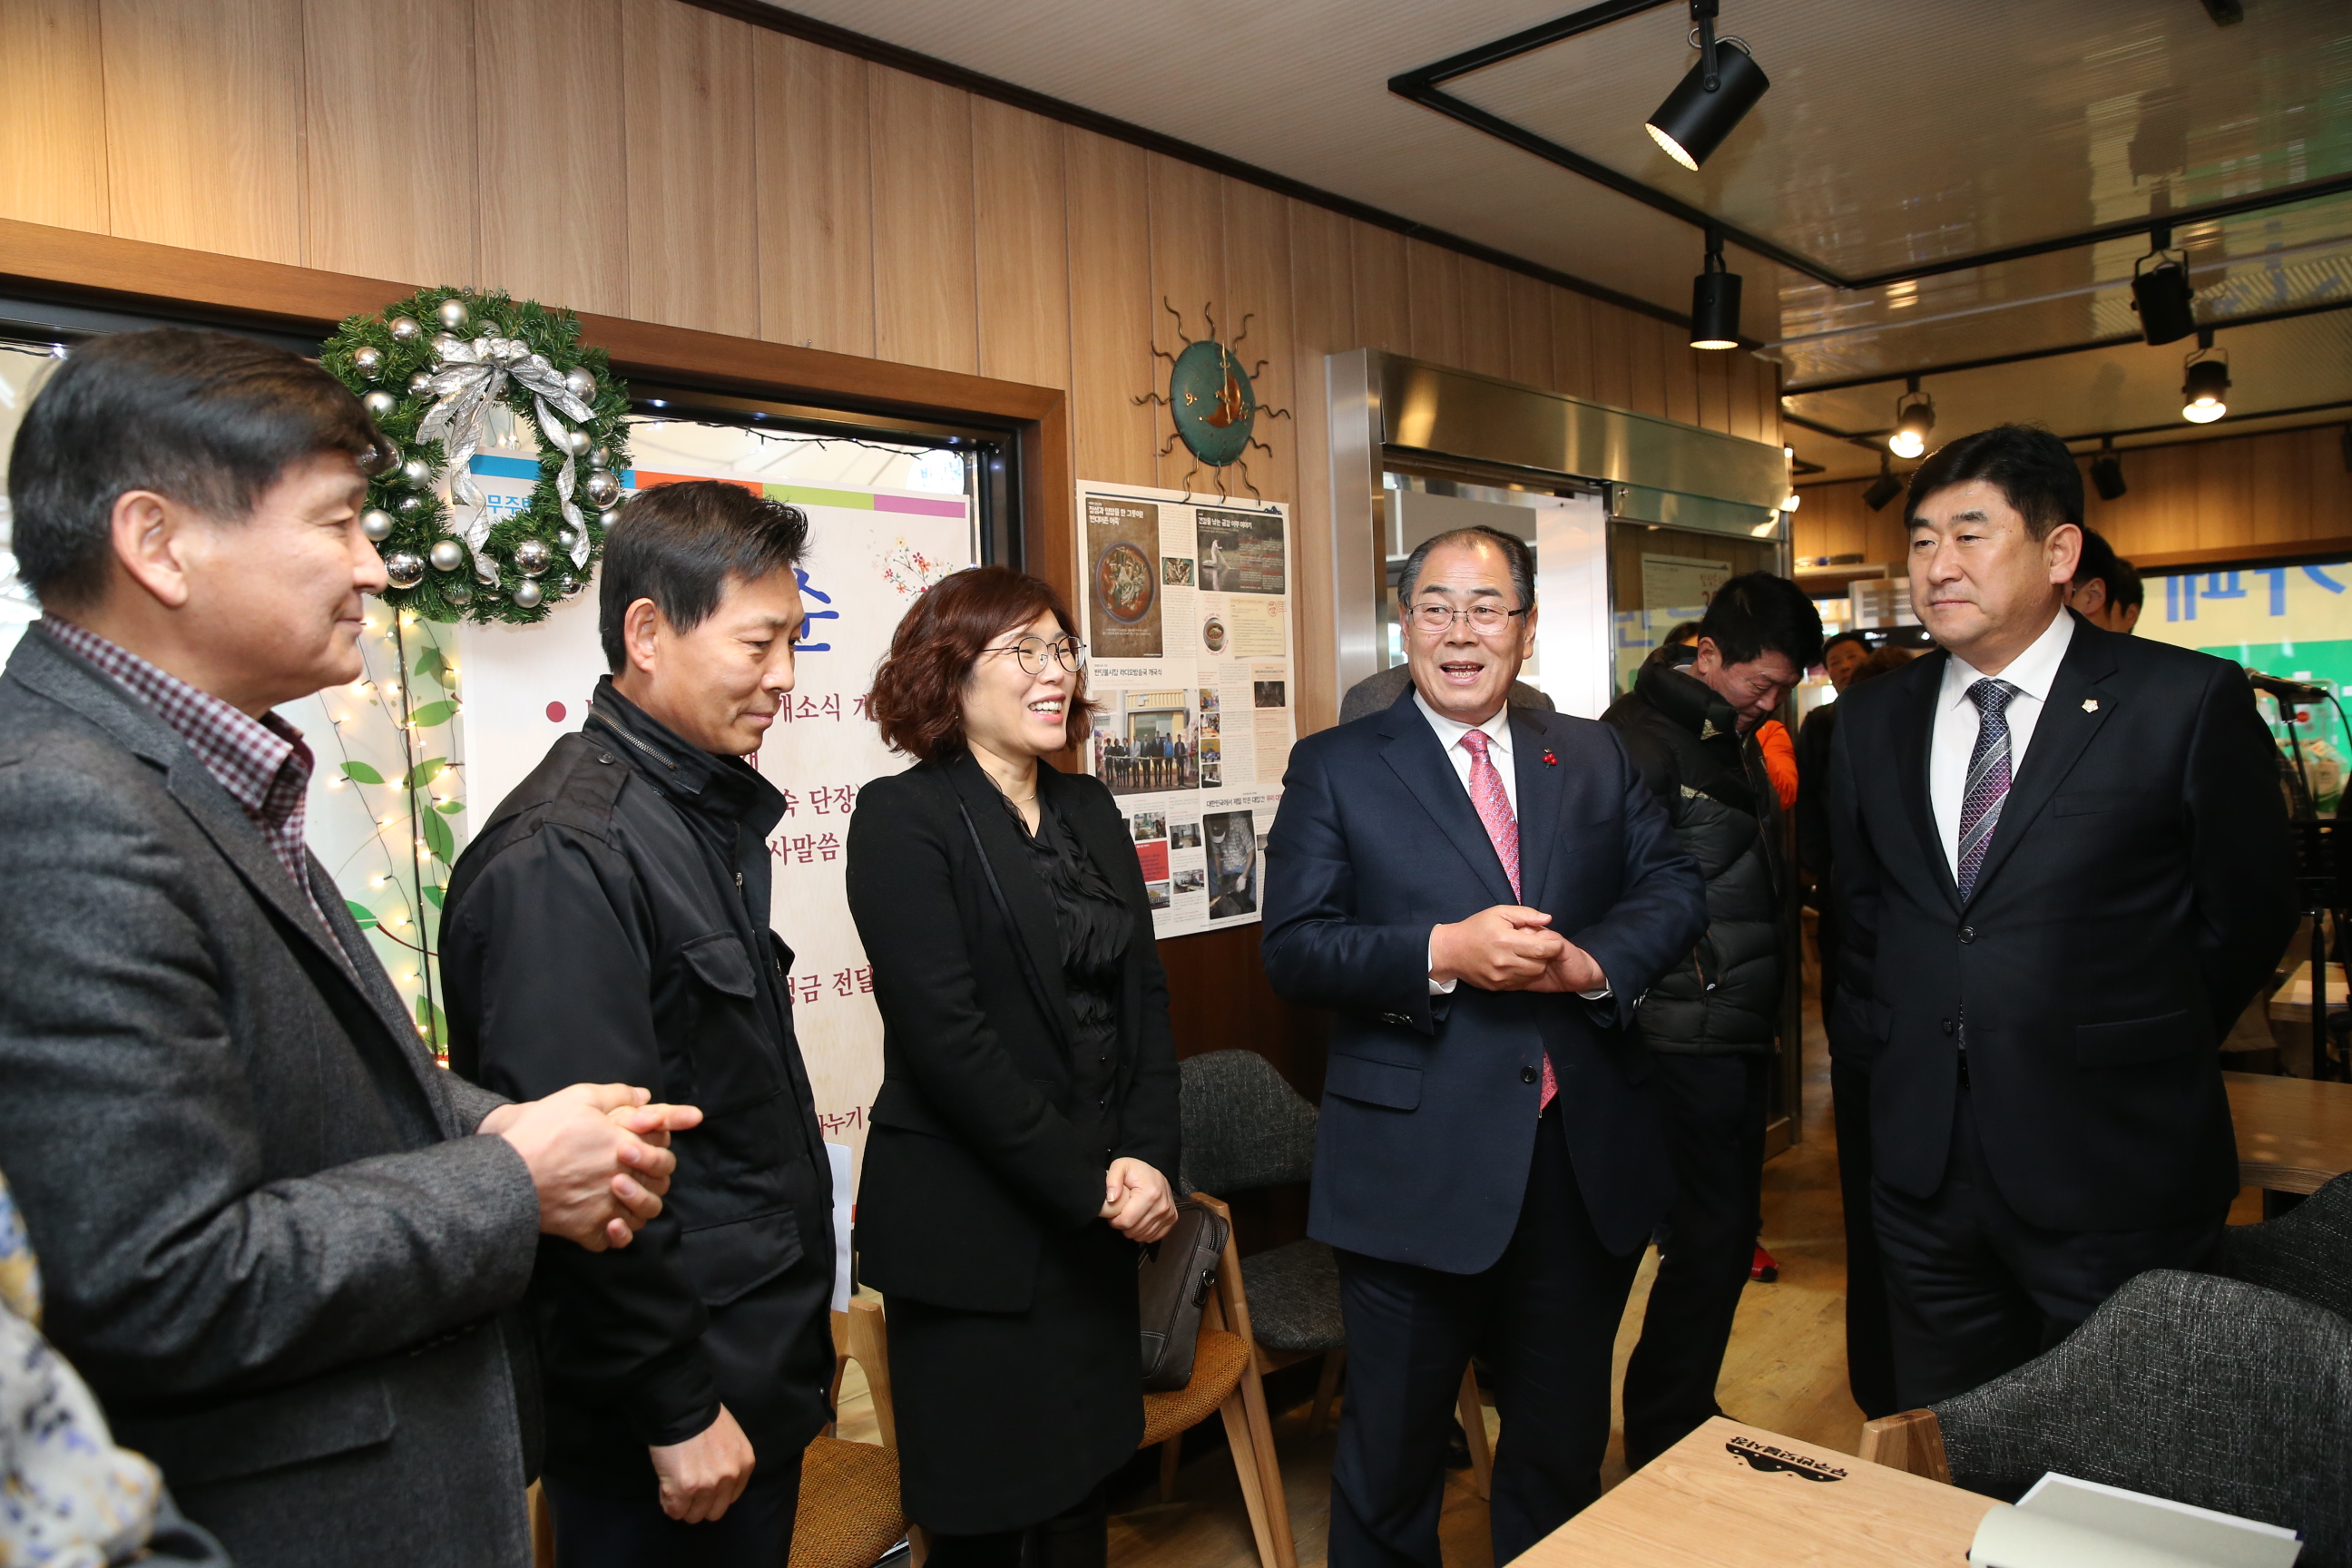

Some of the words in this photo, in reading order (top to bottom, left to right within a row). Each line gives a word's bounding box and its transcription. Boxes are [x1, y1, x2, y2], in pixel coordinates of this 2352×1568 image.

[1094, 668, 1119, 677] 반딧불시장
[1119, 668, 1148, 677] 라디오방송국
[1206, 799, 1233, 808] 대한민국에서
[1730, 1436, 1848, 1477] 무주반딧불시장
